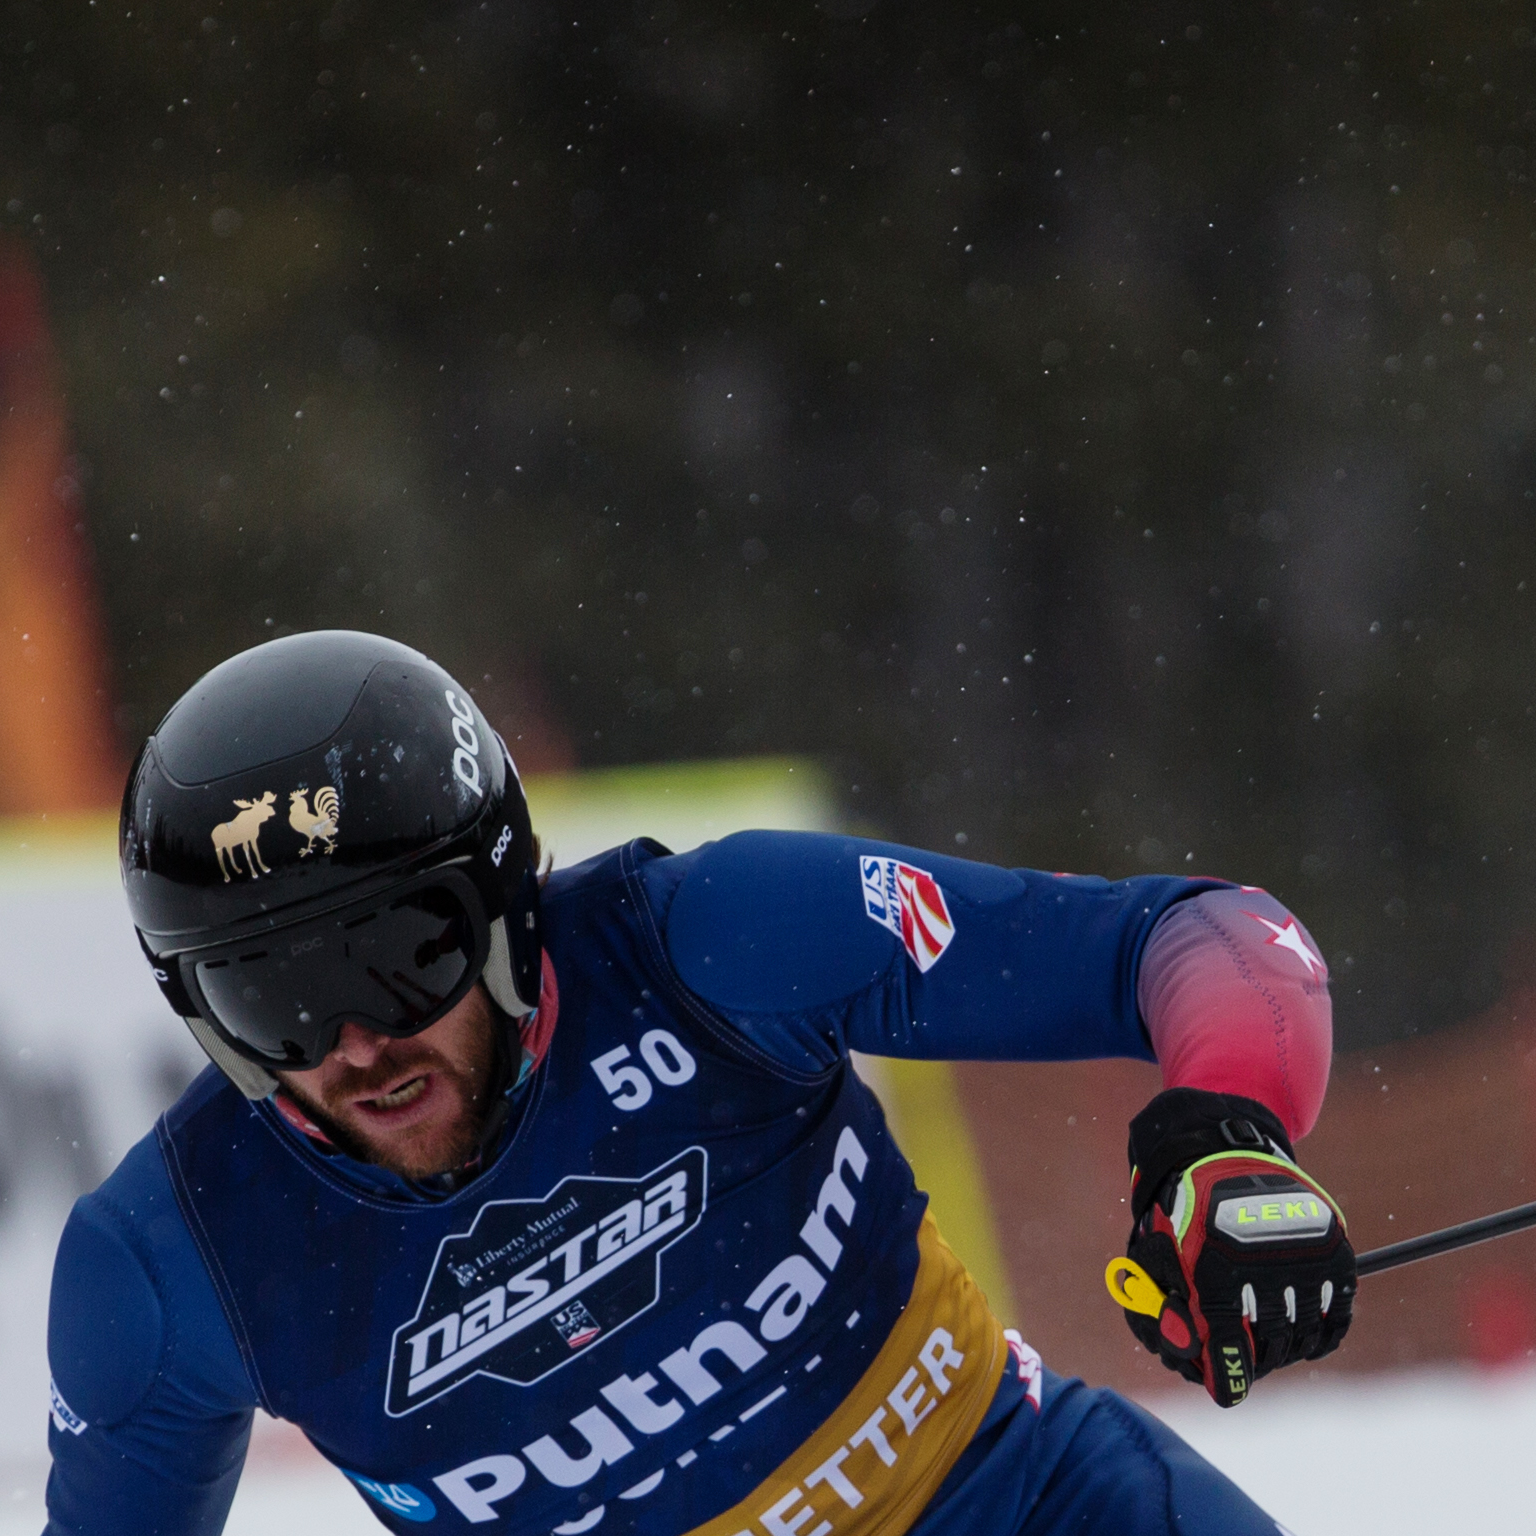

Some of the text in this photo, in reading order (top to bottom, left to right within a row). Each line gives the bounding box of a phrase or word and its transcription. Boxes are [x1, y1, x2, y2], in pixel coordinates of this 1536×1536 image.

[445, 689, 483, 798] POC
[490, 825, 513, 867] POC
[863, 858, 887, 921] US
[590, 1028, 697, 1112] 50
[475, 1196, 580, 1268] Liberty Mutual
[1237, 1201, 1320, 1224] LEKI
[431, 1126, 869, 1524] Putnam
[552, 1302, 584, 1327] US
[1222, 1346, 1247, 1405] LEKI
